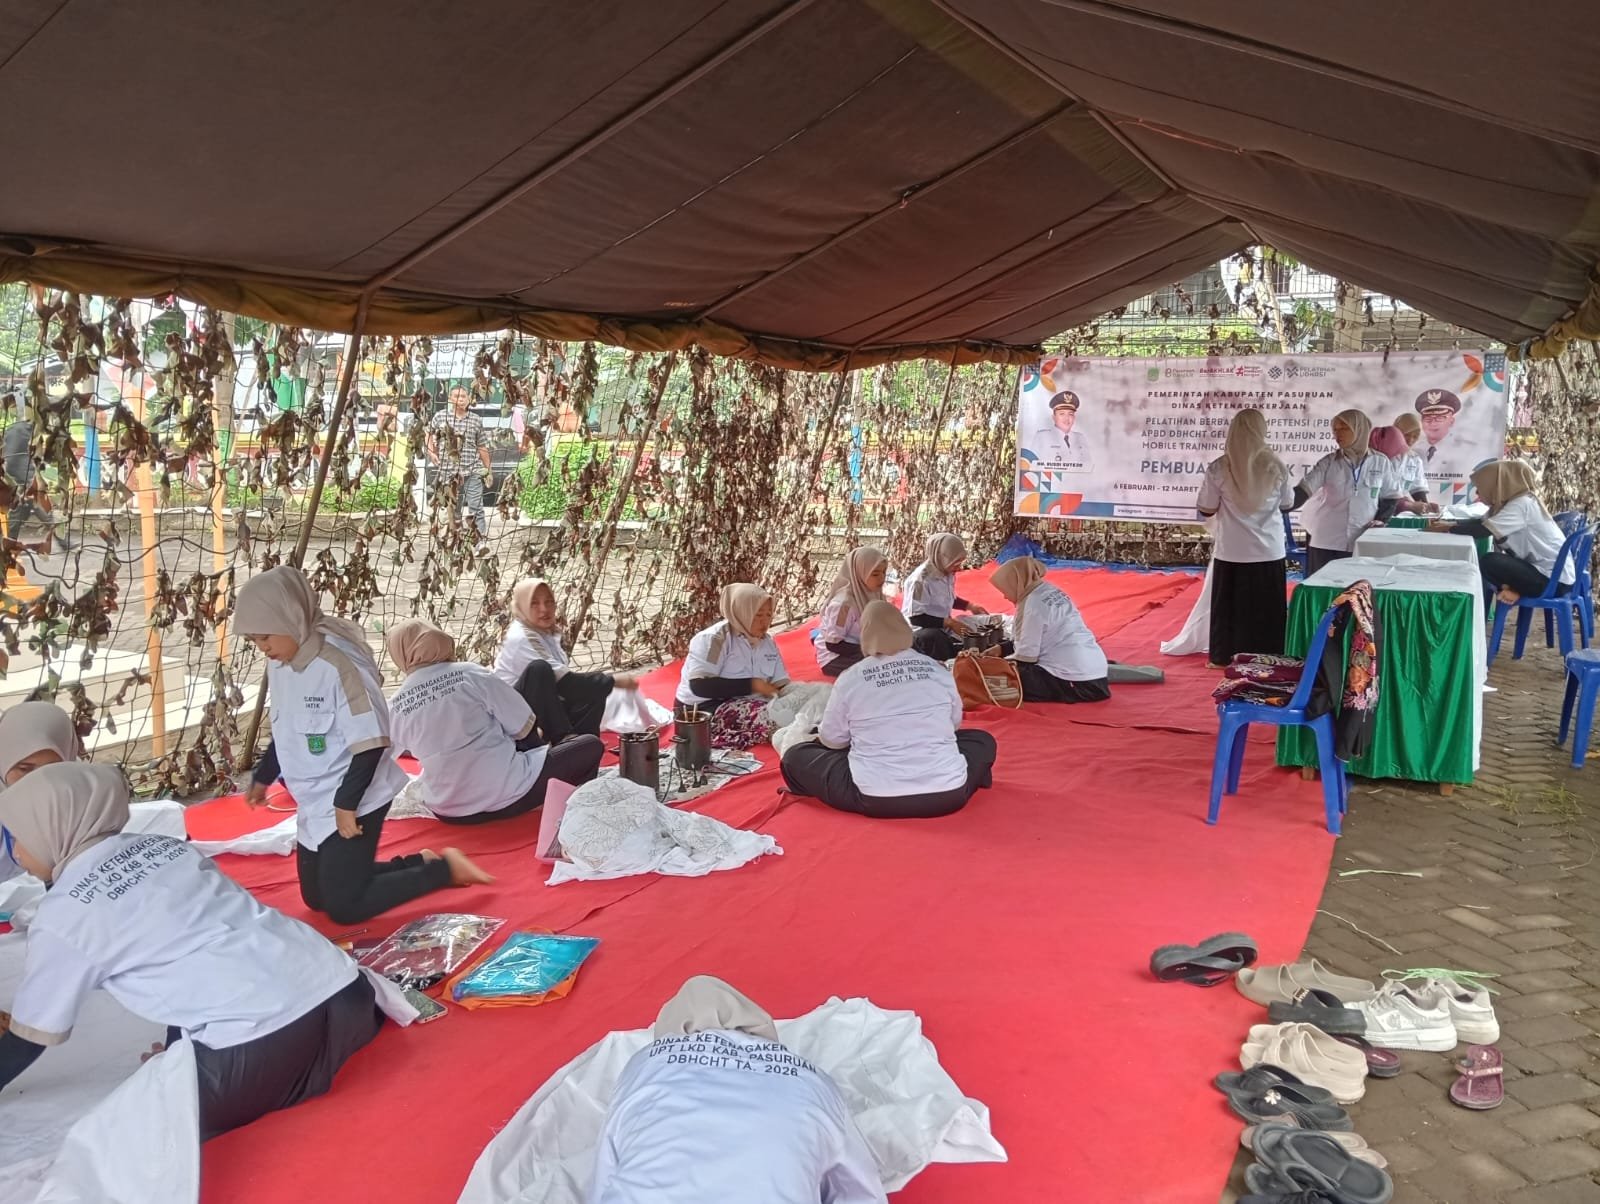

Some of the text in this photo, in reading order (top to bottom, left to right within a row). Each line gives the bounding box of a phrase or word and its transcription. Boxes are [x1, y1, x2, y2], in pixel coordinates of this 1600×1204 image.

[1205, 402, 1307, 410] KETENAGAKERJAAN
[1145, 417, 1196, 426] PELATIHAN
[1141, 429, 1167, 438] APBD
[1169, 430, 1208, 439] DBHCHT
[1281, 431, 1316, 440] TAHUN
[1142, 441, 1177, 450] MOBILE
[1180, 442, 1226, 451] TRAINING
[1285, 443, 1338, 453] KEJURUAN
[1140, 460, 1207, 475] PEMBUA
[1120, 483, 1156, 492] FEBRUARI
[1171, 485, 1200, 493] MARET
[862, 665, 881, 676] DINAS
[407, 670, 464, 697] KETENAGAKERJAAN
[431, 676, 464, 694] PASURUAN
[864, 674, 877, 682] UPT
[876, 676, 904, 688] DBHCHT
[402, 698, 427, 717] DBHCHT
[440, 686, 456, 699] 2026
[68, 872, 100, 899] DINAS
[79, 884, 103, 905] UPT
[100, 871, 123, 889] LKD
[106, 869, 149, 902] DBHCHT
[652, 1035, 690, 1048] DINAS
[649, 1043, 818, 1074] UPT LKD KAB. PASURUAN
[666, 1053, 799, 1078] DBHCHT TA. 2026
